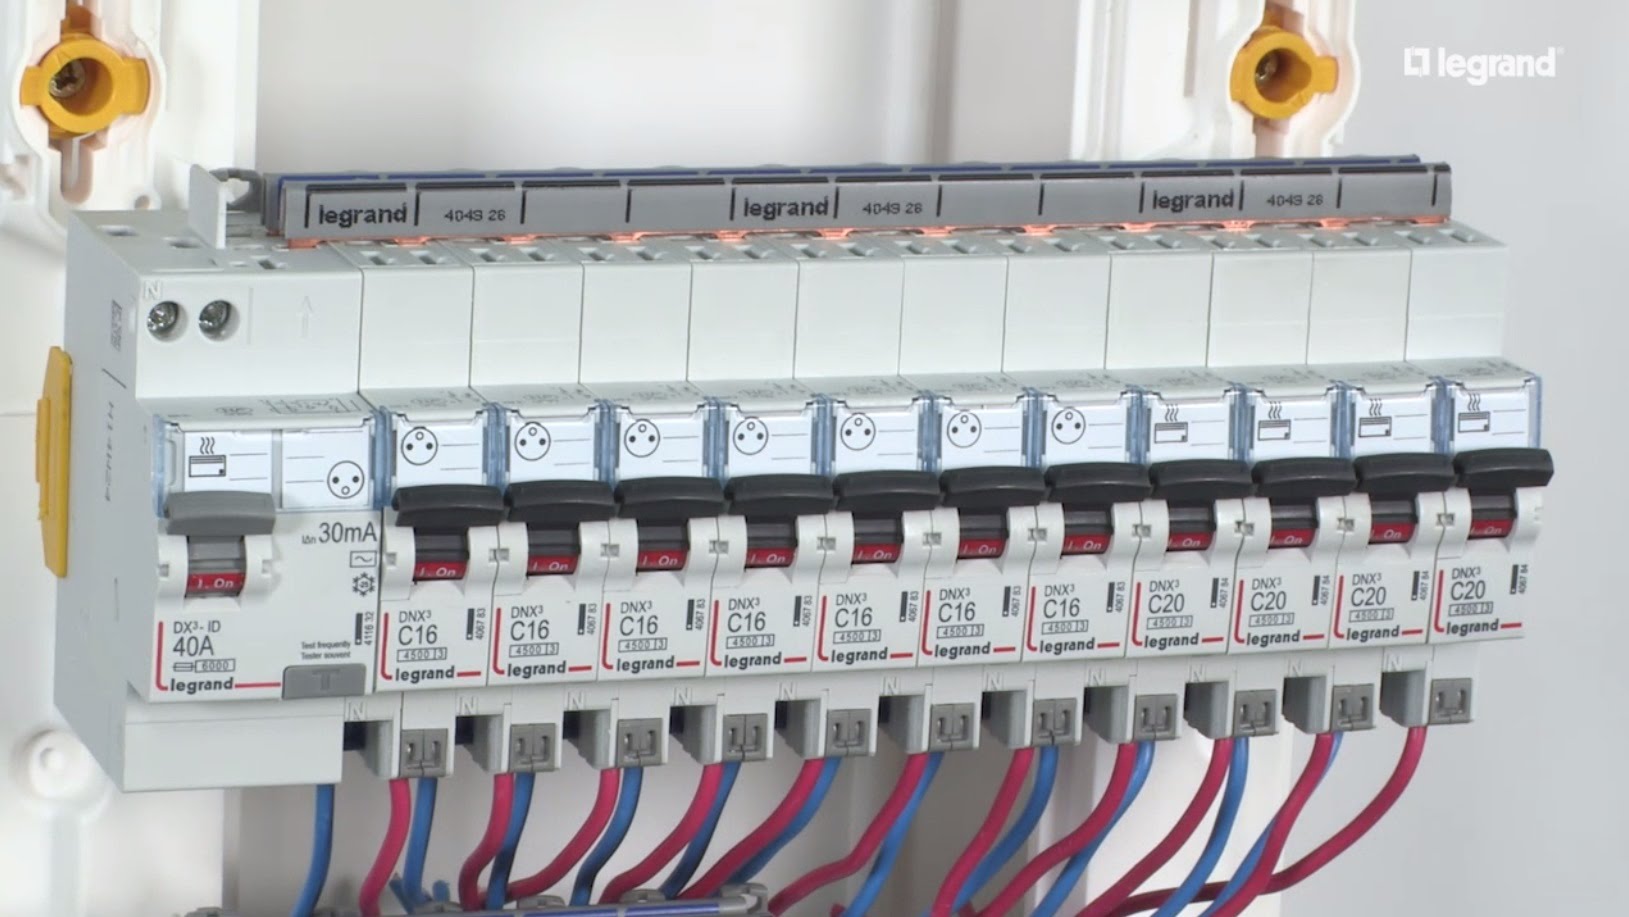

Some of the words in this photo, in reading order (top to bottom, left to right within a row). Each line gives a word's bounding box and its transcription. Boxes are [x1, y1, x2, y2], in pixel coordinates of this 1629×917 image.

[743, 195, 829, 221] legrand
[1152, 188, 1234, 213] legrand
[318, 201, 407, 229] legrand
[318, 521, 378, 544] 30mA
[213, 577, 235, 589] On
[1451, 580, 1485, 600] C20
[1148, 593, 1185, 614] C20
[1251, 591, 1287, 611] C20
[1351, 587, 1386, 607] C20
[835, 607, 872, 628] C16
[939, 601, 976, 622] C16
[1044, 598, 1080, 618] C16
[511, 620, 549, 641] C16
[620, 615, 658, 636] C16
[728, 611, 766, 633] C16
[943, 627, 967, 635] 4500
[1048, 623, 1072, 632] 4500
[1447, 618, 1499, 636] legrand
[398, 624, 437, 645] C16
[732, 637, 757, 646] 4500
[840, 632, 864, 640] 4500
[1144, 632, 1199, 650] legrand
[1247, 629, 1300, 647] legrand
[1347, 625, 1399, 642] legrand
[172, 635, 215, 657] 40A
[403, 651, 429, 659] 4500
[516, 645, 541, 655] 4500
[625, 641, 650, 650] 4500
[935, 642, 991, 659] legrand
[1040, 637, 1095, 655] legrand
[201, 660, 230, 671] 6000
[617, 655, 674, 674] legrand
[724, 652, 782, 670] legrand
[831, 647, 888, 665] legrand
[396, 665, 455, 684] legrand
[508, 660, 566, 679] legrand
[170, 676, 234, 695] legrand
